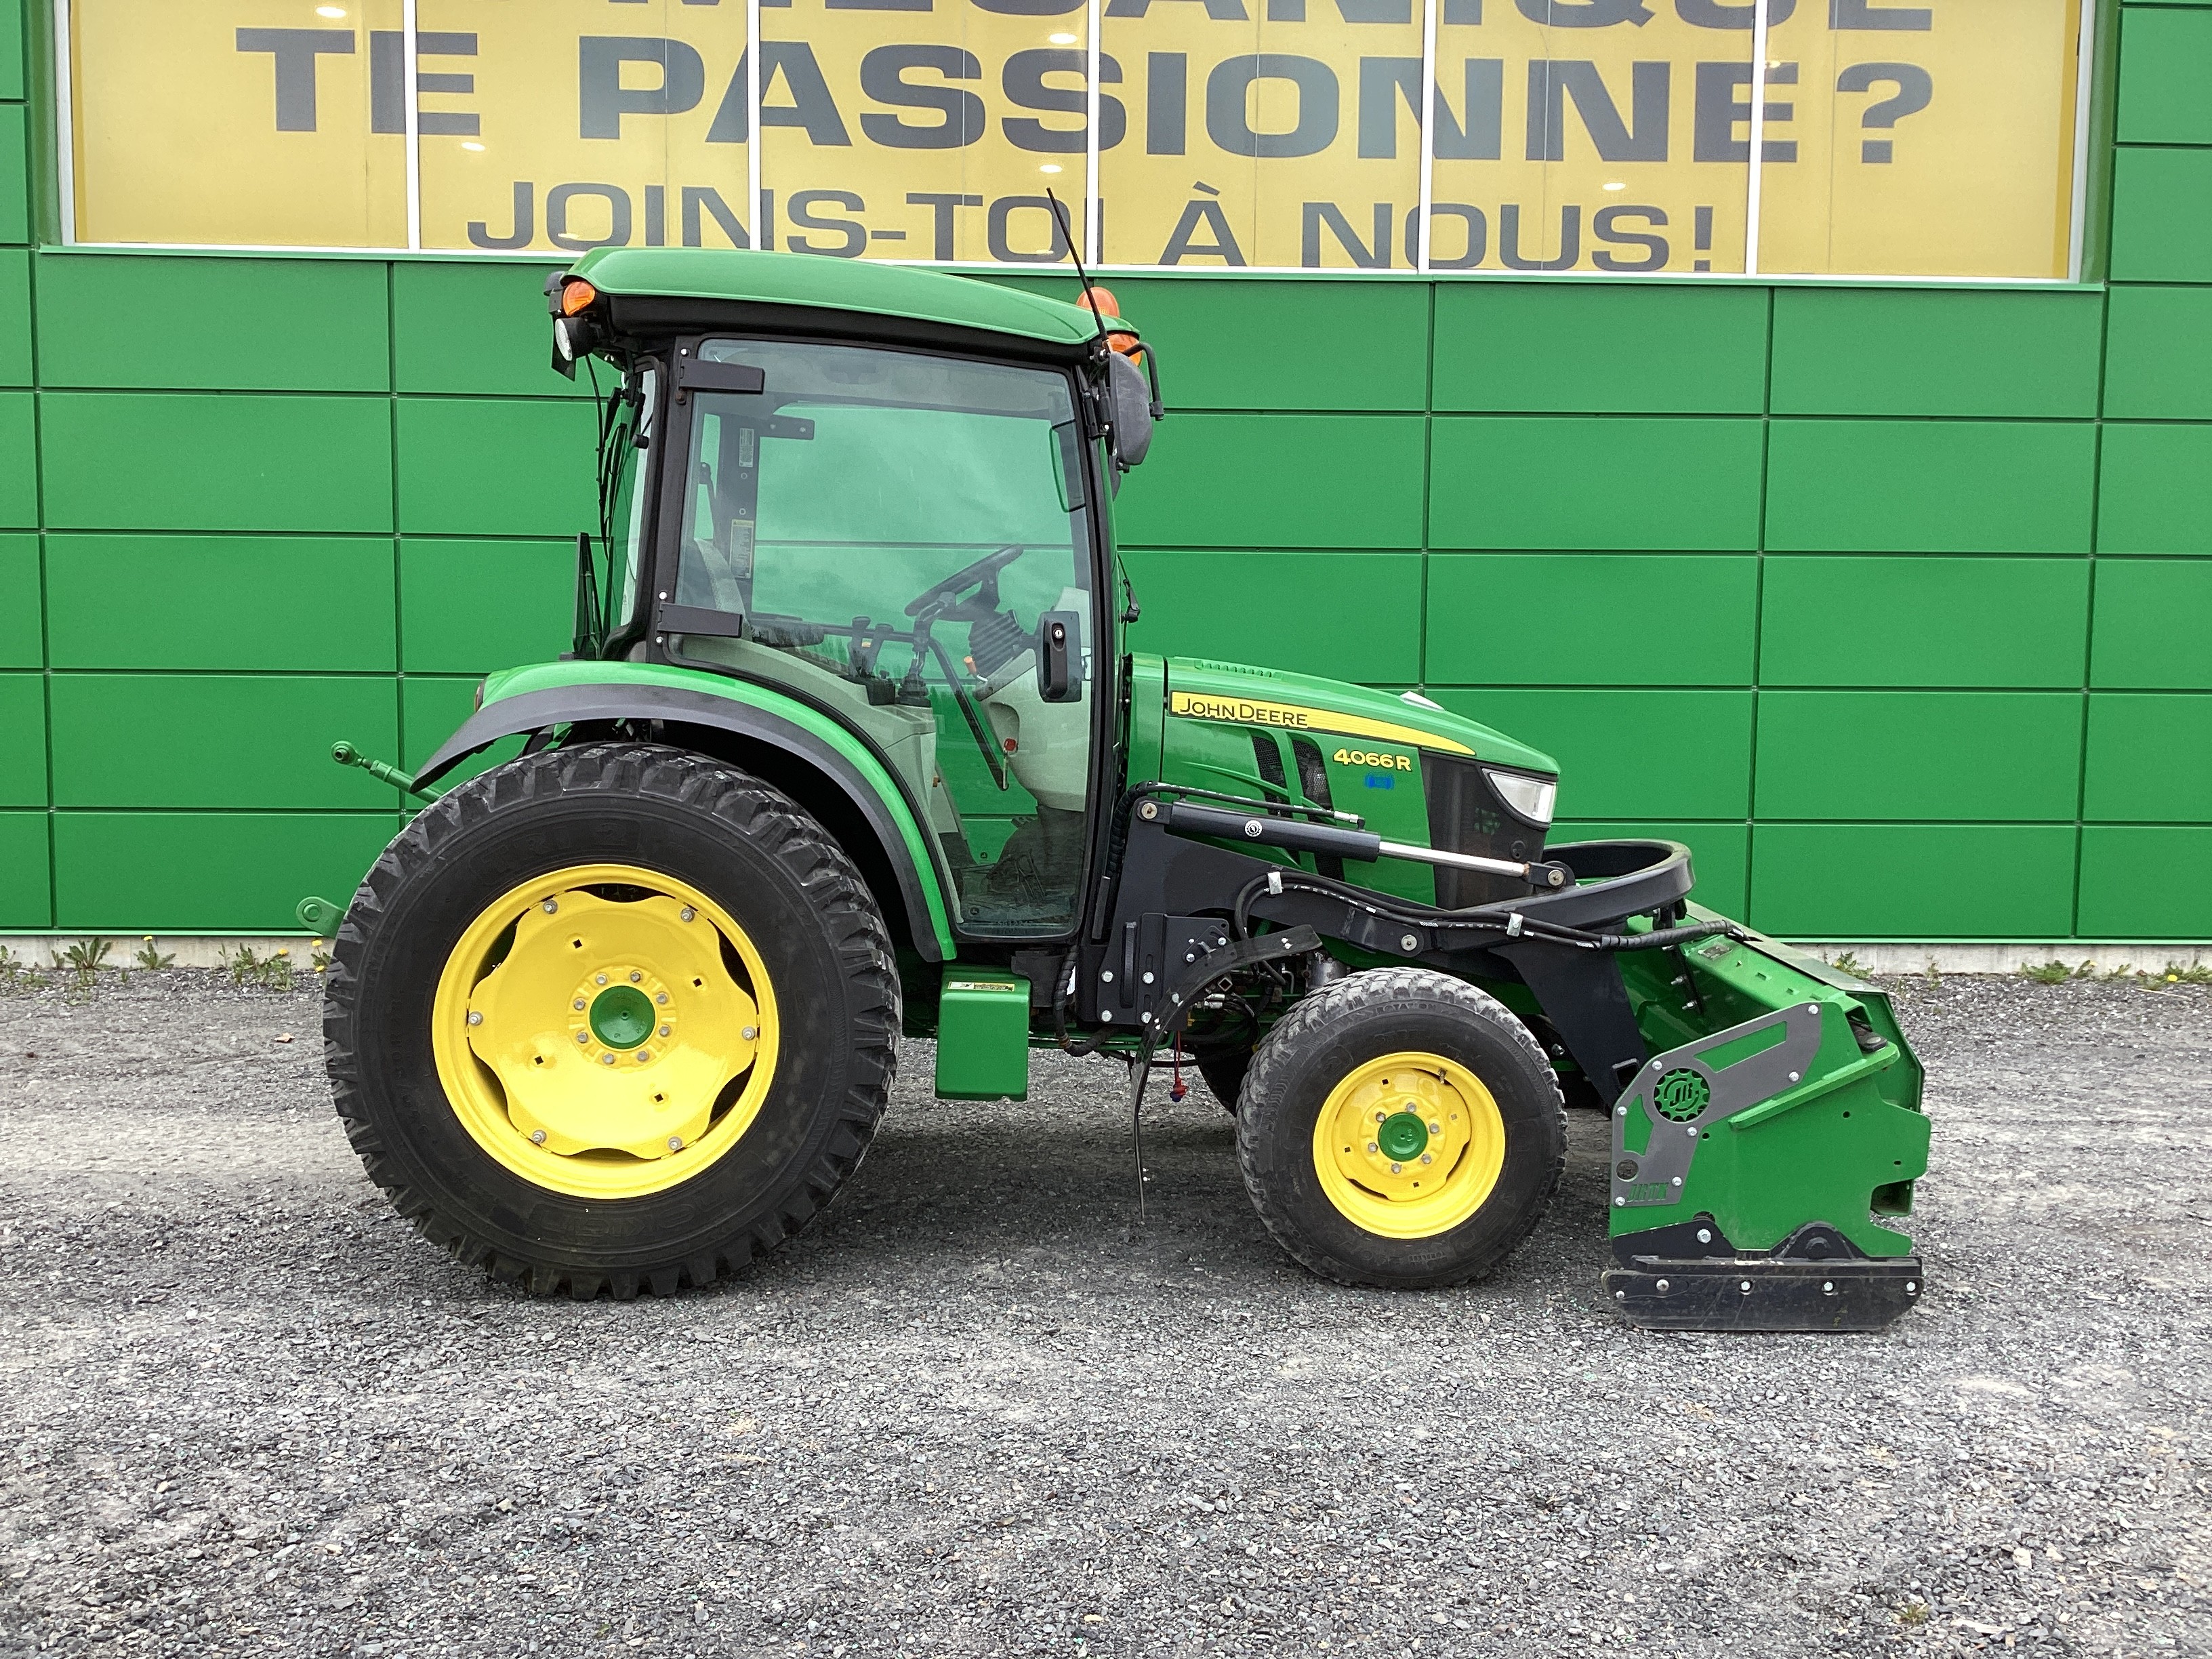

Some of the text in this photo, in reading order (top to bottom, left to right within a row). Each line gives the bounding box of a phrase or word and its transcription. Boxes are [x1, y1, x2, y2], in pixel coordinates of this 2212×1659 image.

[235, 28, 480, 136] TE
[1157, 180, 1248, 267] À
[1301, 201, 1714, 272] NOUS!
[1332, 748, 1412, 771] 4066R
